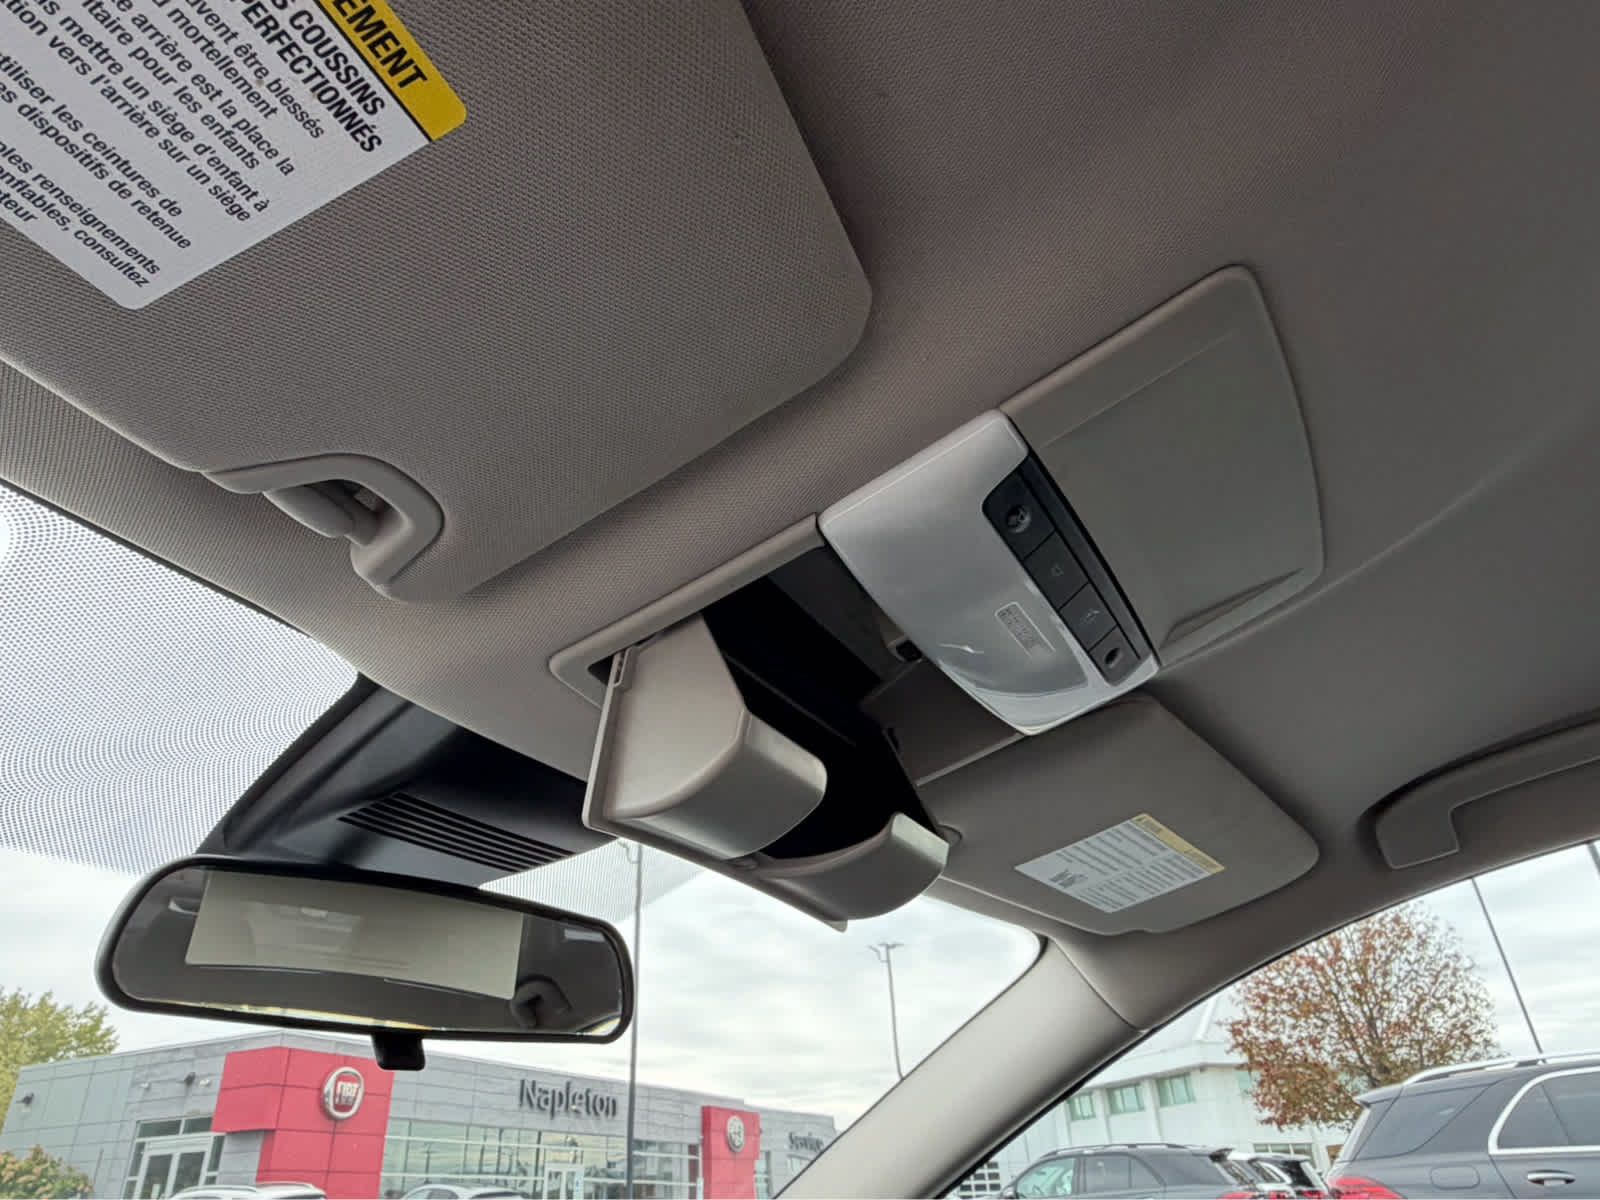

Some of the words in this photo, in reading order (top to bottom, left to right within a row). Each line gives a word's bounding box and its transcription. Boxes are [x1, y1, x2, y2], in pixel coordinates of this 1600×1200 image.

[0, 0, 48, 35] tion
[49, 36, 92, 75] vers
[90, 74, 160, 138] l'arrière
[158, 138, 190, 163] sur
[186, 164, 211, 185] un
[208, 184, 250, 221] siège
[59, 16, 124, 75] mettre
[122, 76, 150, 100] un
[148, 100, 195, 143] siège
[193, 143, 259, 201] d'enfant
[253, 199, 270, 212] à
[128, 46, 178, 85] pour
[173, 86, 202, 113] les
[200, 114, 260, 169] enfants
[131, 14, 192, 73] arrière
[191, 74, 223, 101] est
[217, 99, 238, 119] la
[231, 118, 279, 159] place
[276, 158, 295, 176] la
[167, 8, 278, 118] mortellement
[230, 0, 382, 152] ERFECTIONNÉS
[233, 43, 269, 79] être
[266, 78, 324, 138] blessés
[289, 10, 385, 116] COUSSINS
[17, 104, 109, 180] dispositifs
[108, 180, 132, 199] de
[131, 200, 191, 248] retenue
[52, 104, 83, 132] les
[82, 132, 160, 198] ceintures
[158, 198, 182, 217] de
[32, 173, 160, 275] renseignements
[74, 230, 150, 287] consultez
[519, 1079, 617, 1120] Napleton
